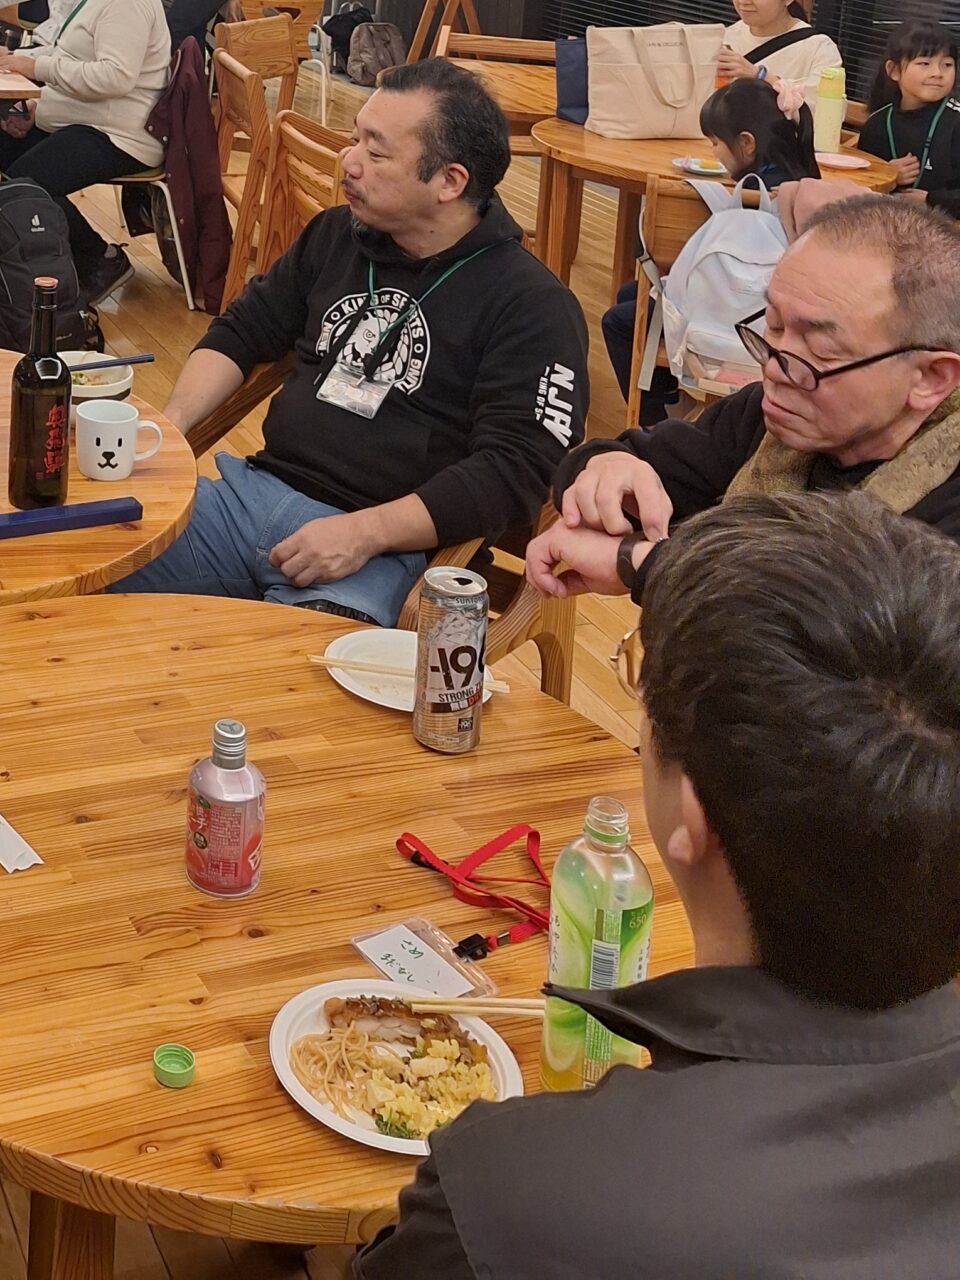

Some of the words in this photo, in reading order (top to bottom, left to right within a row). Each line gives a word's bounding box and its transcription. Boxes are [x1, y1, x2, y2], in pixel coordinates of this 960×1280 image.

[381, 295, 391, 304] OF
[456, 596, 482, 604] SUNTO
[438, 686, 474, 703] STRONG
